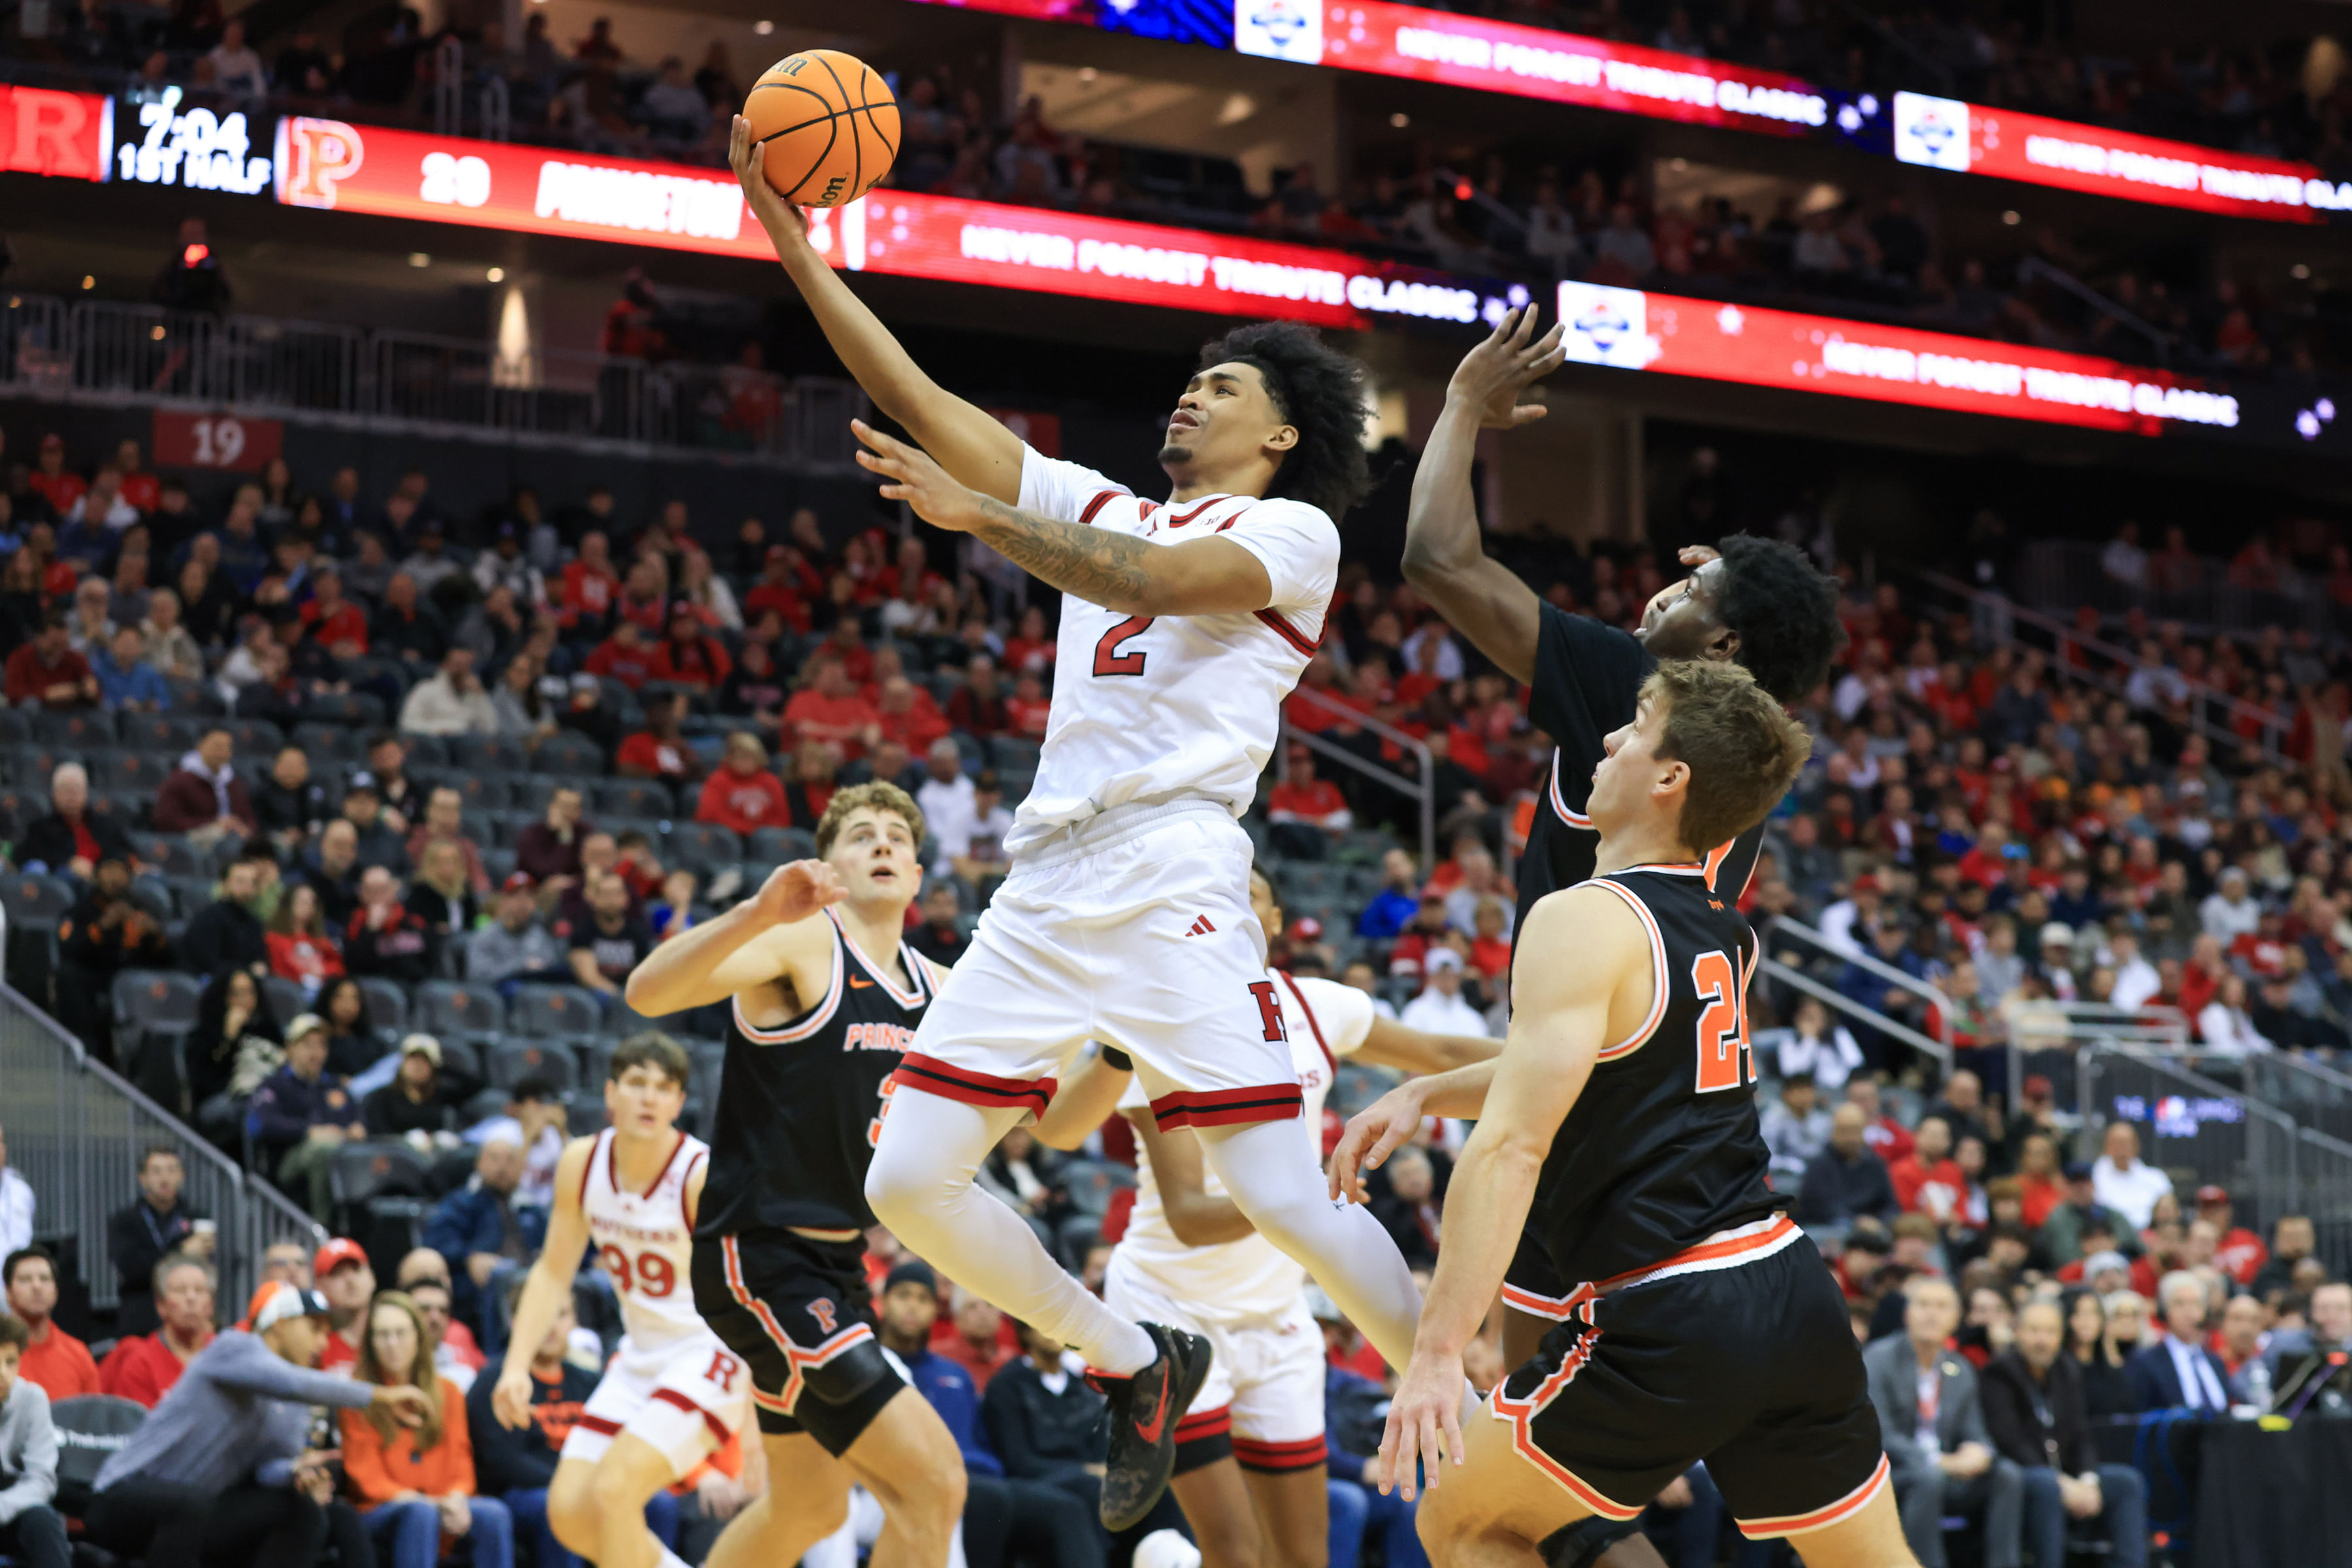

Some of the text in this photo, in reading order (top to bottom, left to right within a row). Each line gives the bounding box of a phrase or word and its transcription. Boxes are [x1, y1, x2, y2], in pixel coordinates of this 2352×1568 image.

[1396, 26, 1827, 126] NEVER FORGET TRIBUTE CLASSIC
[9, 85, 92, 175] R
[139, 101, 250, 161] 7:04
[118, 142, 184, 185] 1ST
[184, 152, 272, 195] HALF
[291, 116, 365, 210] P
[960, 223, 1478, 323] NEVER FORGET TRIBUTE CLASSIC
[2132, 383, 2240, 427] CLASSIC
[192, 416, 245, 466] 19
[1092, 610, 1156, 677] 2
[602, 1243, 675, 1298] 99
[806, 1296, 839, 1334] P
[704, 1350, 740, 1392] R
